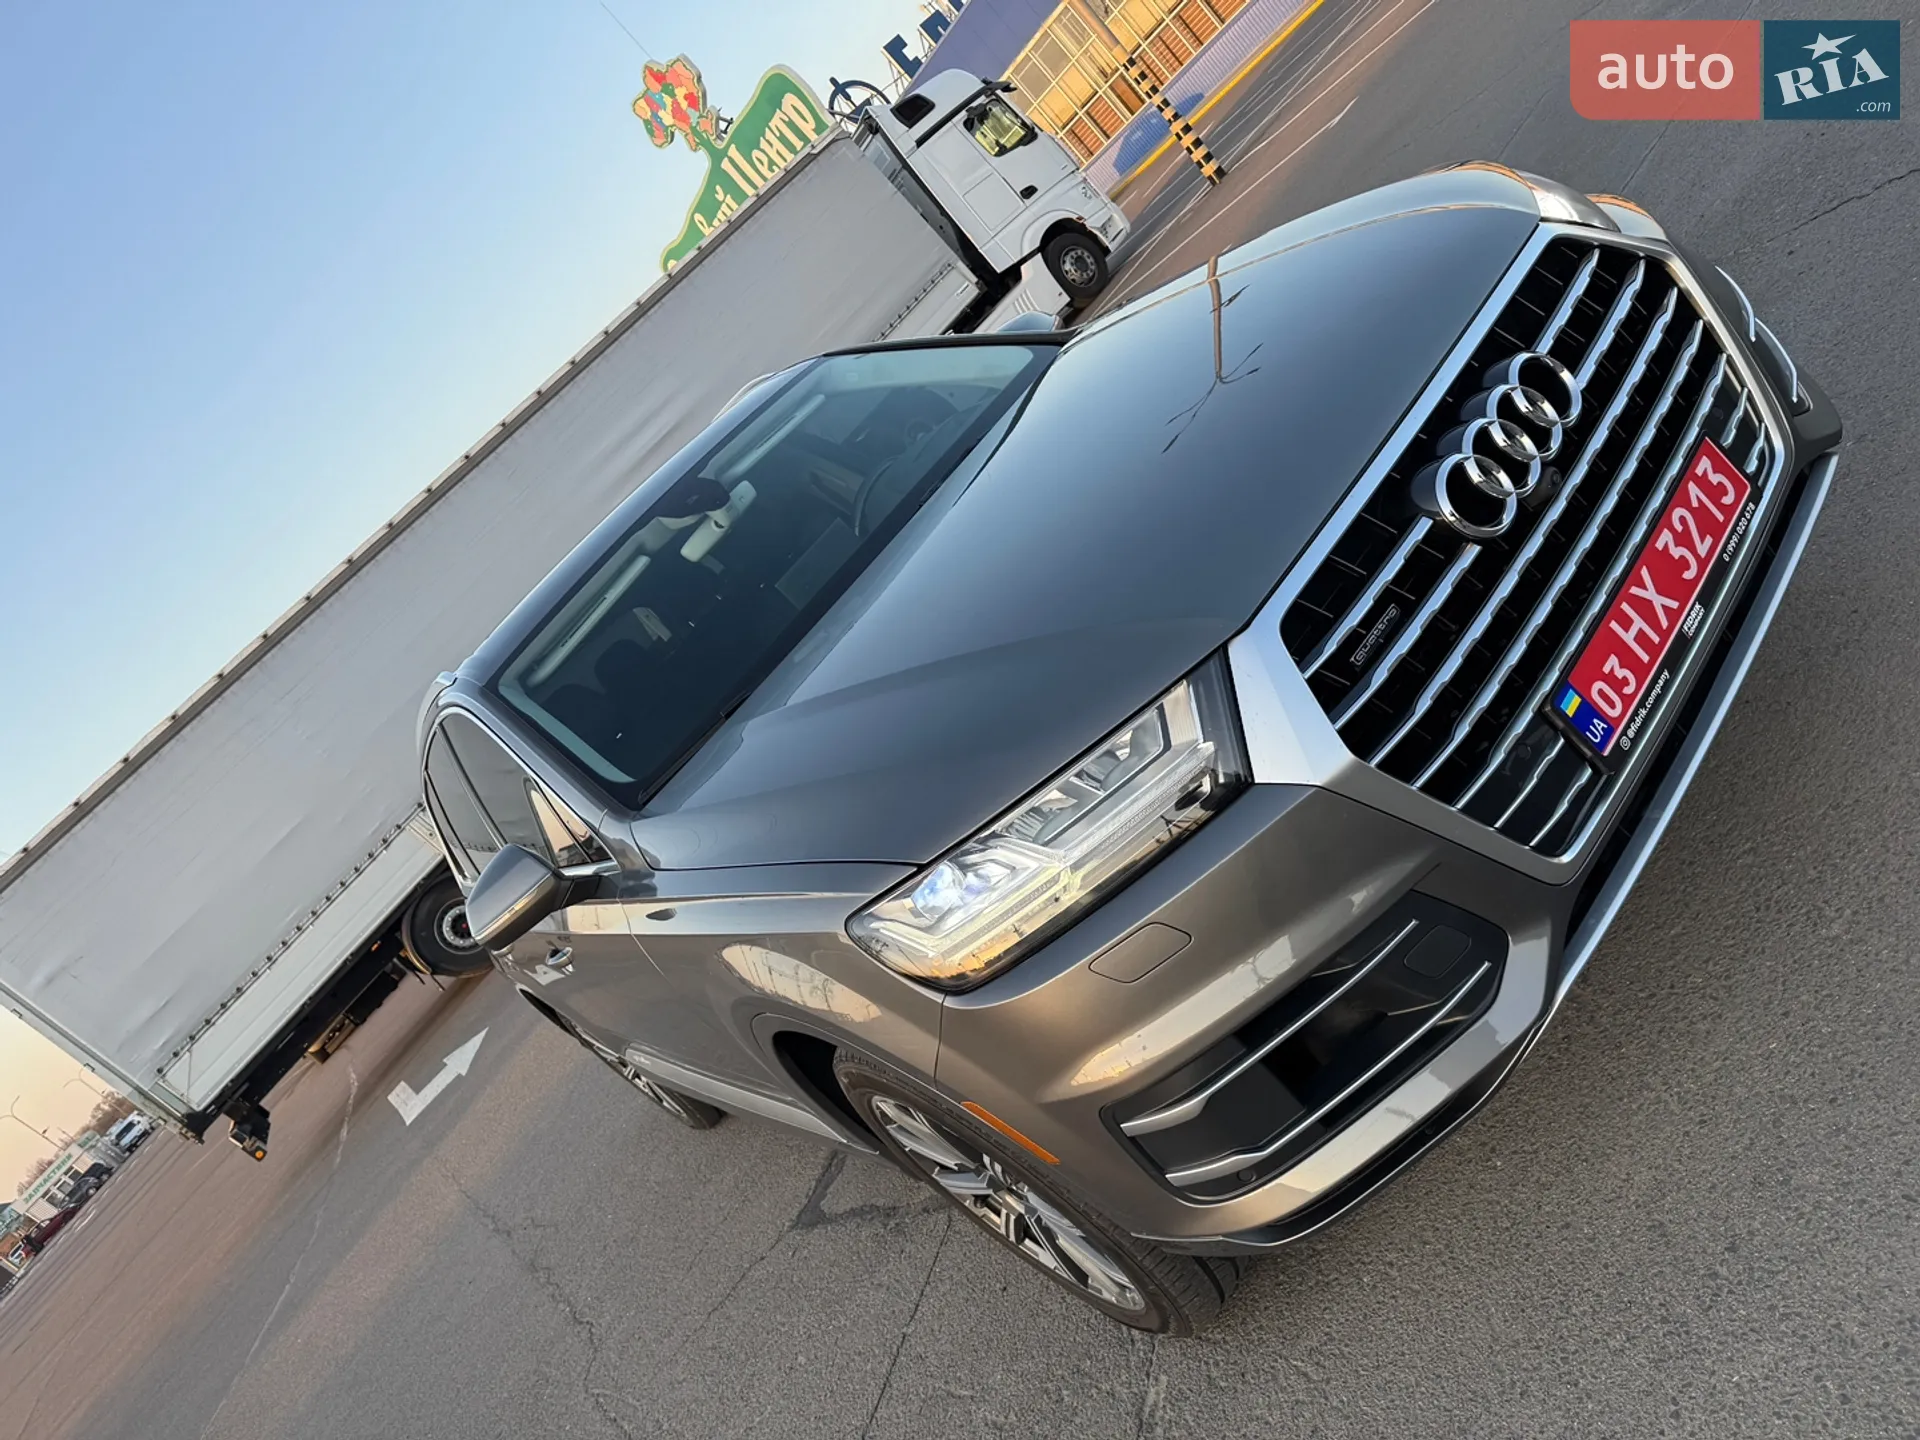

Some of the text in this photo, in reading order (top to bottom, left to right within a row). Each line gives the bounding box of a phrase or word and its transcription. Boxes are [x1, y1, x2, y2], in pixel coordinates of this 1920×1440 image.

[1590, 653, 1637, 718] 03
[1655, 455, 1735, 580] 3213
[1355, 607, 1398, 665] quattro
[1585, 718, 1608, 743] UA
[1626, 668, 1670, 739] @fidrik.company
